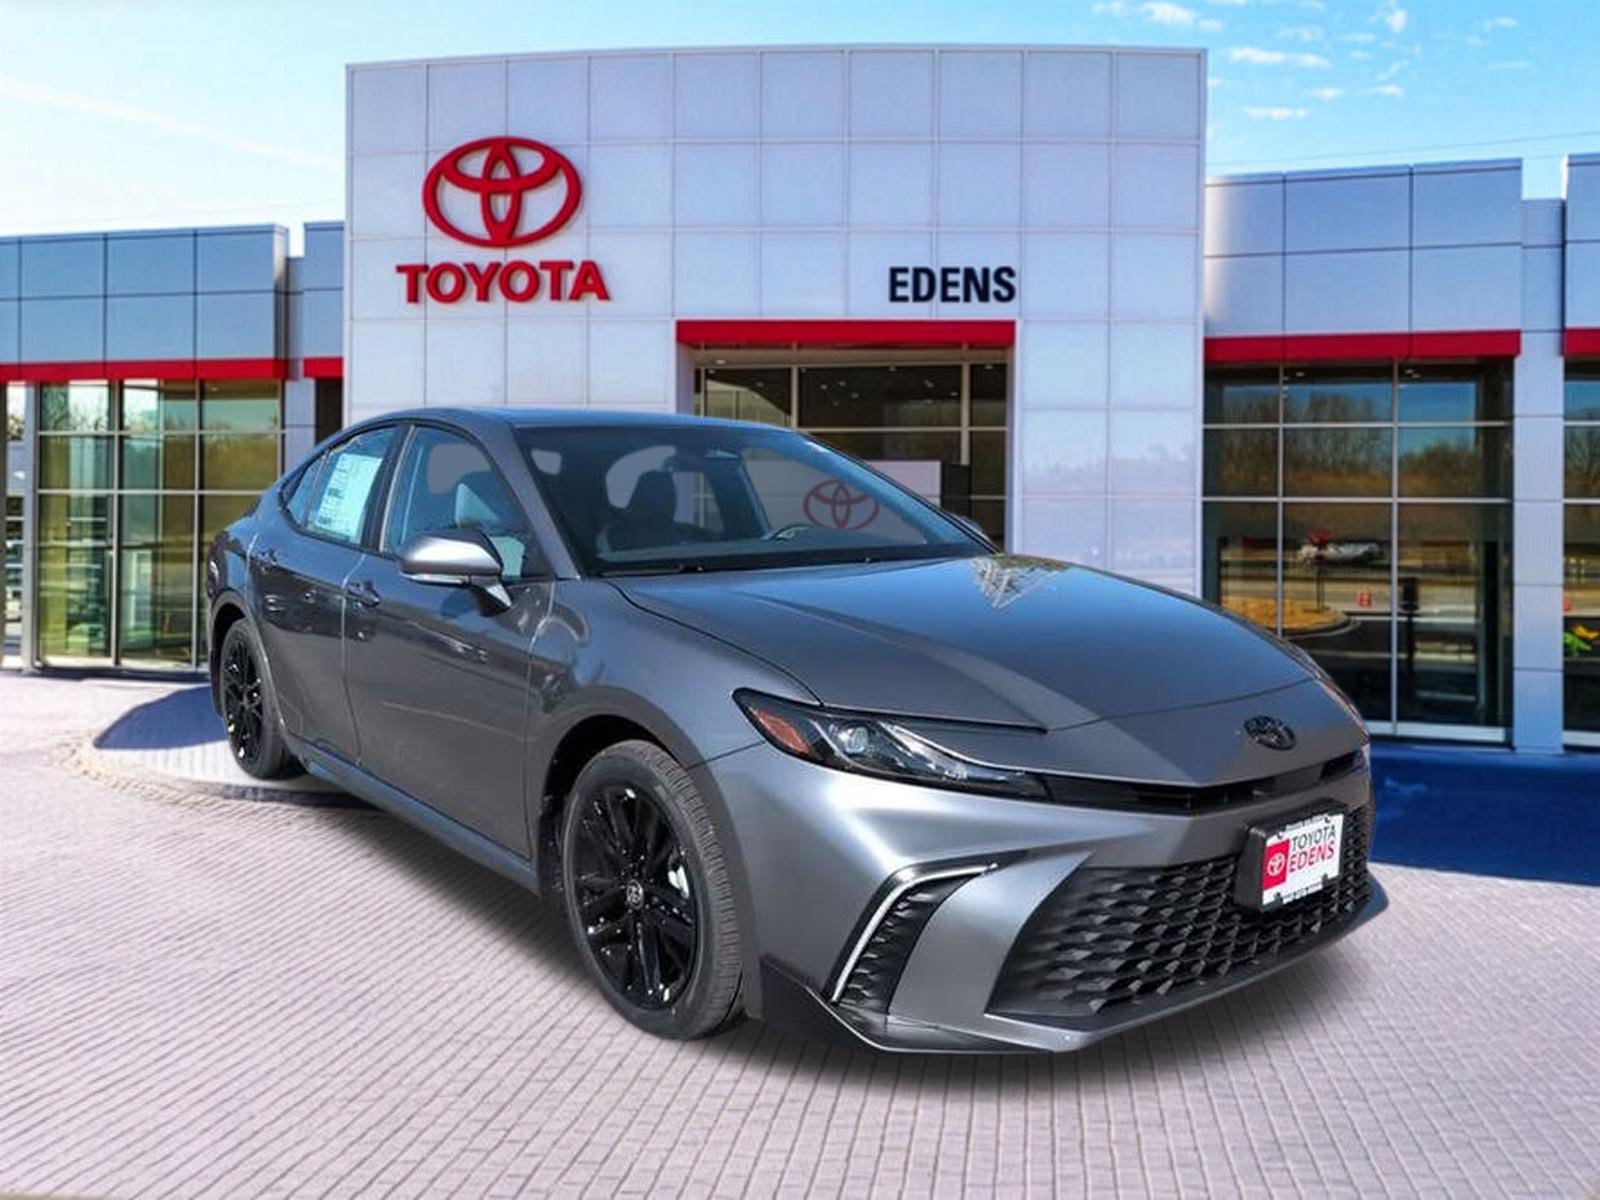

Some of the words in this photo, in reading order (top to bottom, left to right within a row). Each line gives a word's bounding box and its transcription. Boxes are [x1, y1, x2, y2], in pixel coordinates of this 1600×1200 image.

[396, 260, 611, 304] TOYOTA
[889, 266, 1017, 303] EDENS
[1292, 824, 1336, 852] TOYOTA
[1288, 840, 1335, 873] EDENS
